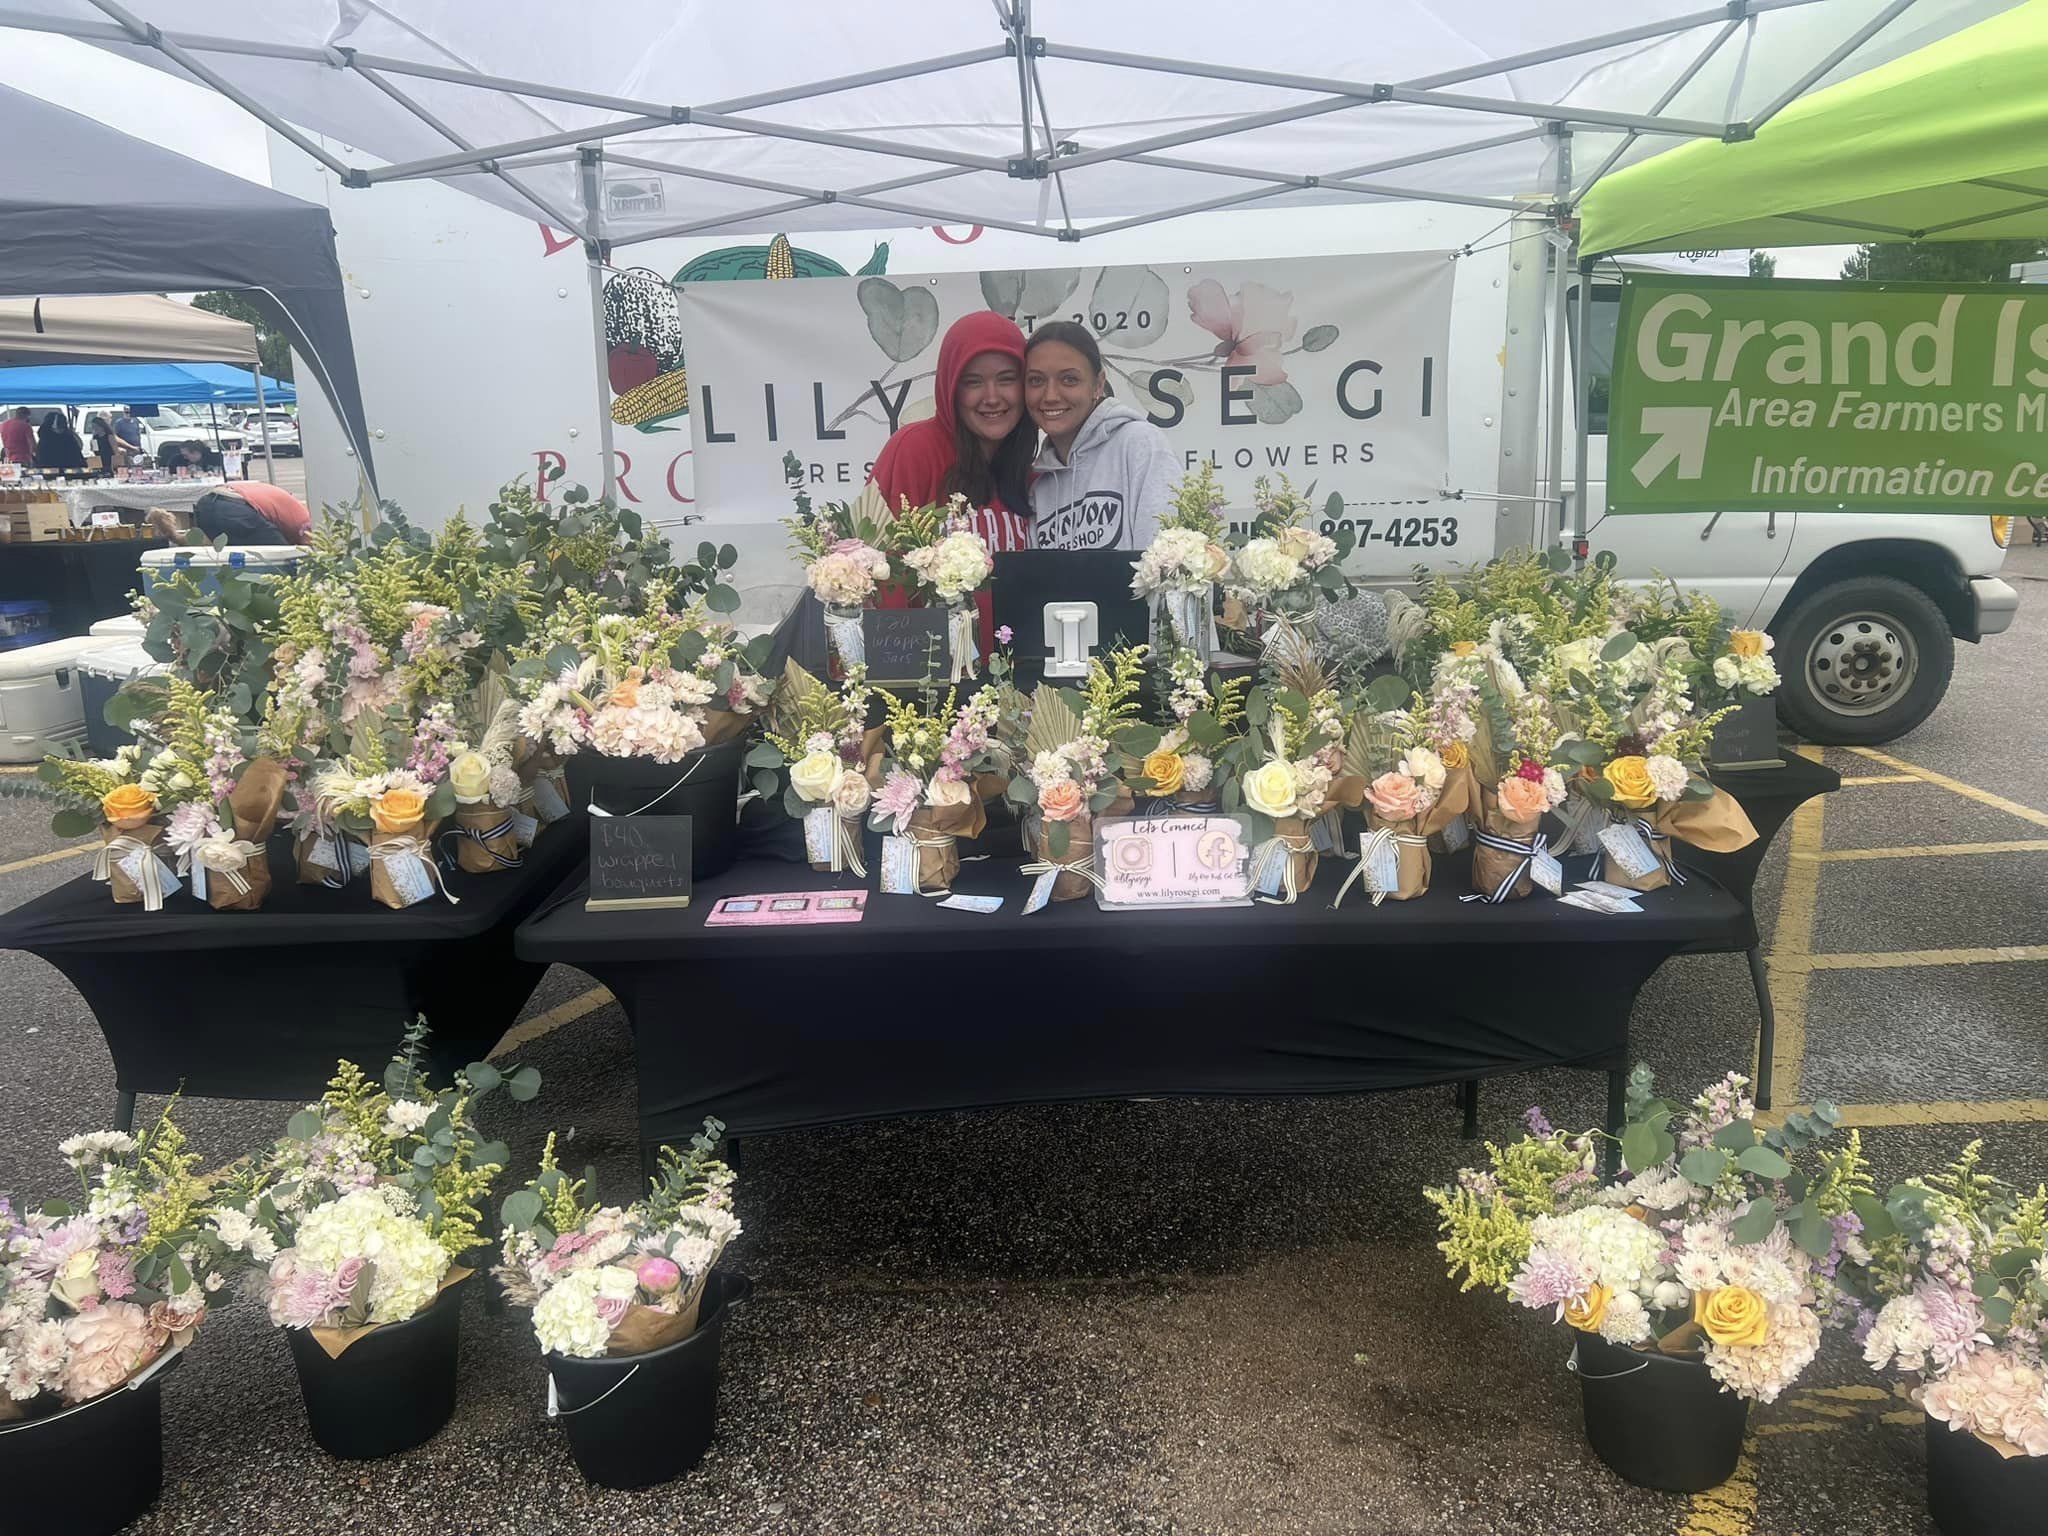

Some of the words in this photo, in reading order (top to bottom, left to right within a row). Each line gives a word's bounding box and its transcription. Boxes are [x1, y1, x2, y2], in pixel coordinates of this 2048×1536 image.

[1636, 293, 1966, 387] Grand
[701, 379, 913, 442] LILY
[1104, 365, 1258, 429] SE
[1336, 357, 1433, 420] GI
[1715, 387, 1816, 428] Area
[1827, 391, 2003, 432] Farmers
[1185, 442, 1375, 471] FLOWERS
[1751, 456, 1994, 496] Information
[1073, 528, 1104, 549] SHOP
[1161, 816, 1208, 834] Connect
[1137, 887, 1220, 898] www.lilyrosegi.com
